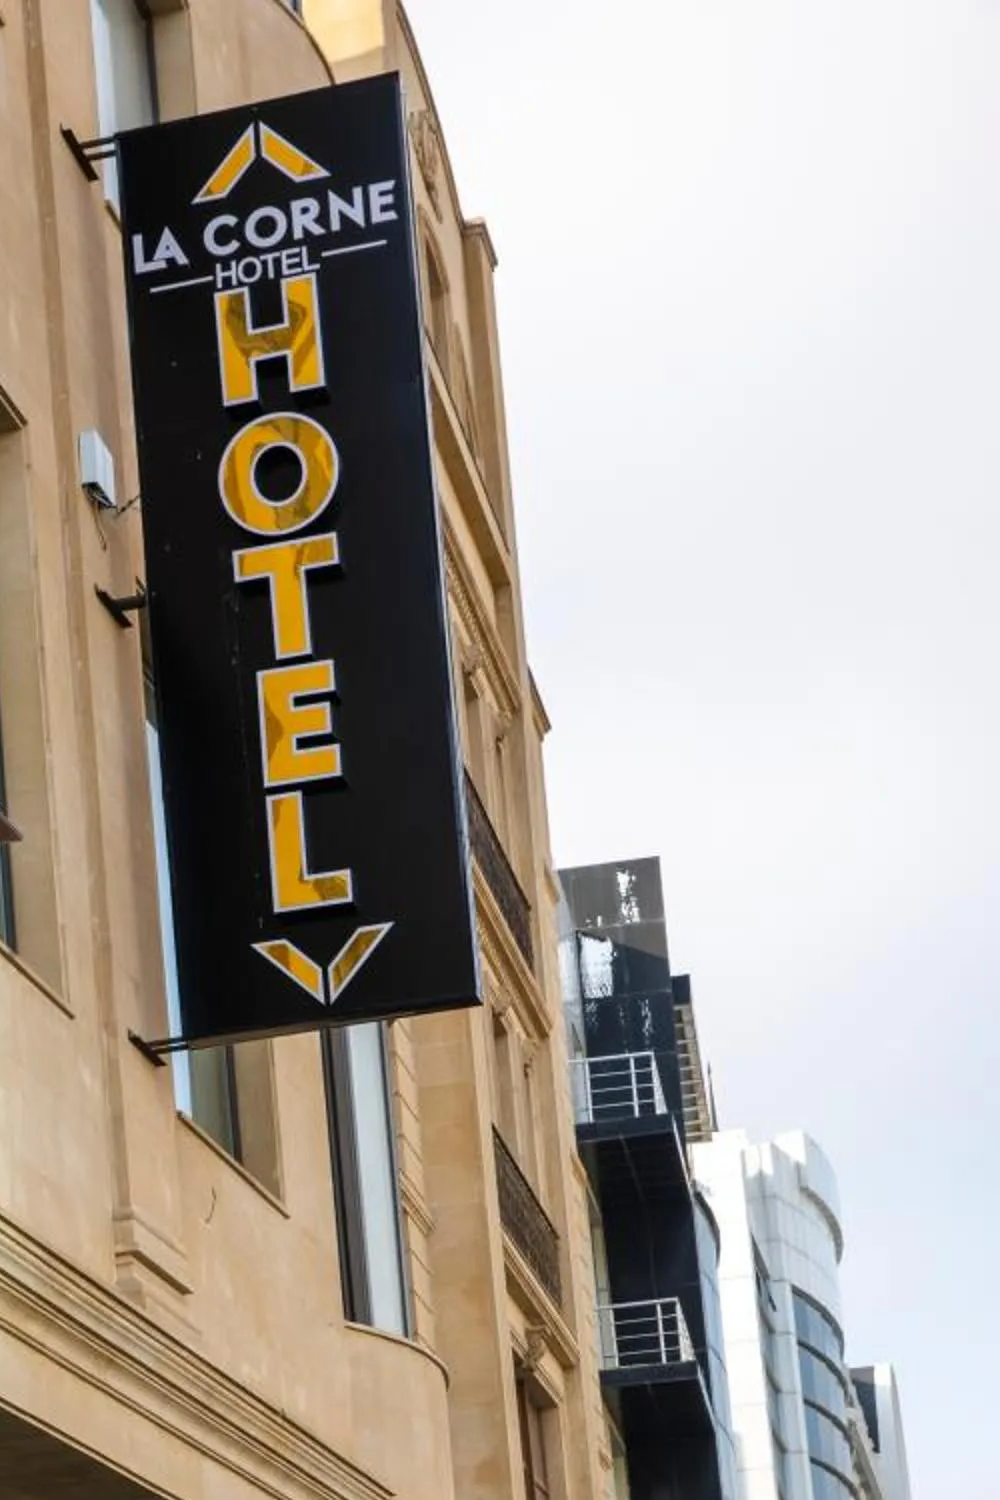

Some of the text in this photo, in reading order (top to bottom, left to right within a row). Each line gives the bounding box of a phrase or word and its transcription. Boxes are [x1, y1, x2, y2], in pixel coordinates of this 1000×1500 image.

[132, 179, 398, 275] LA CORNE
[215, 246, 321, 289] HOTEL
[213, 272, 353, 915] HOTEL
